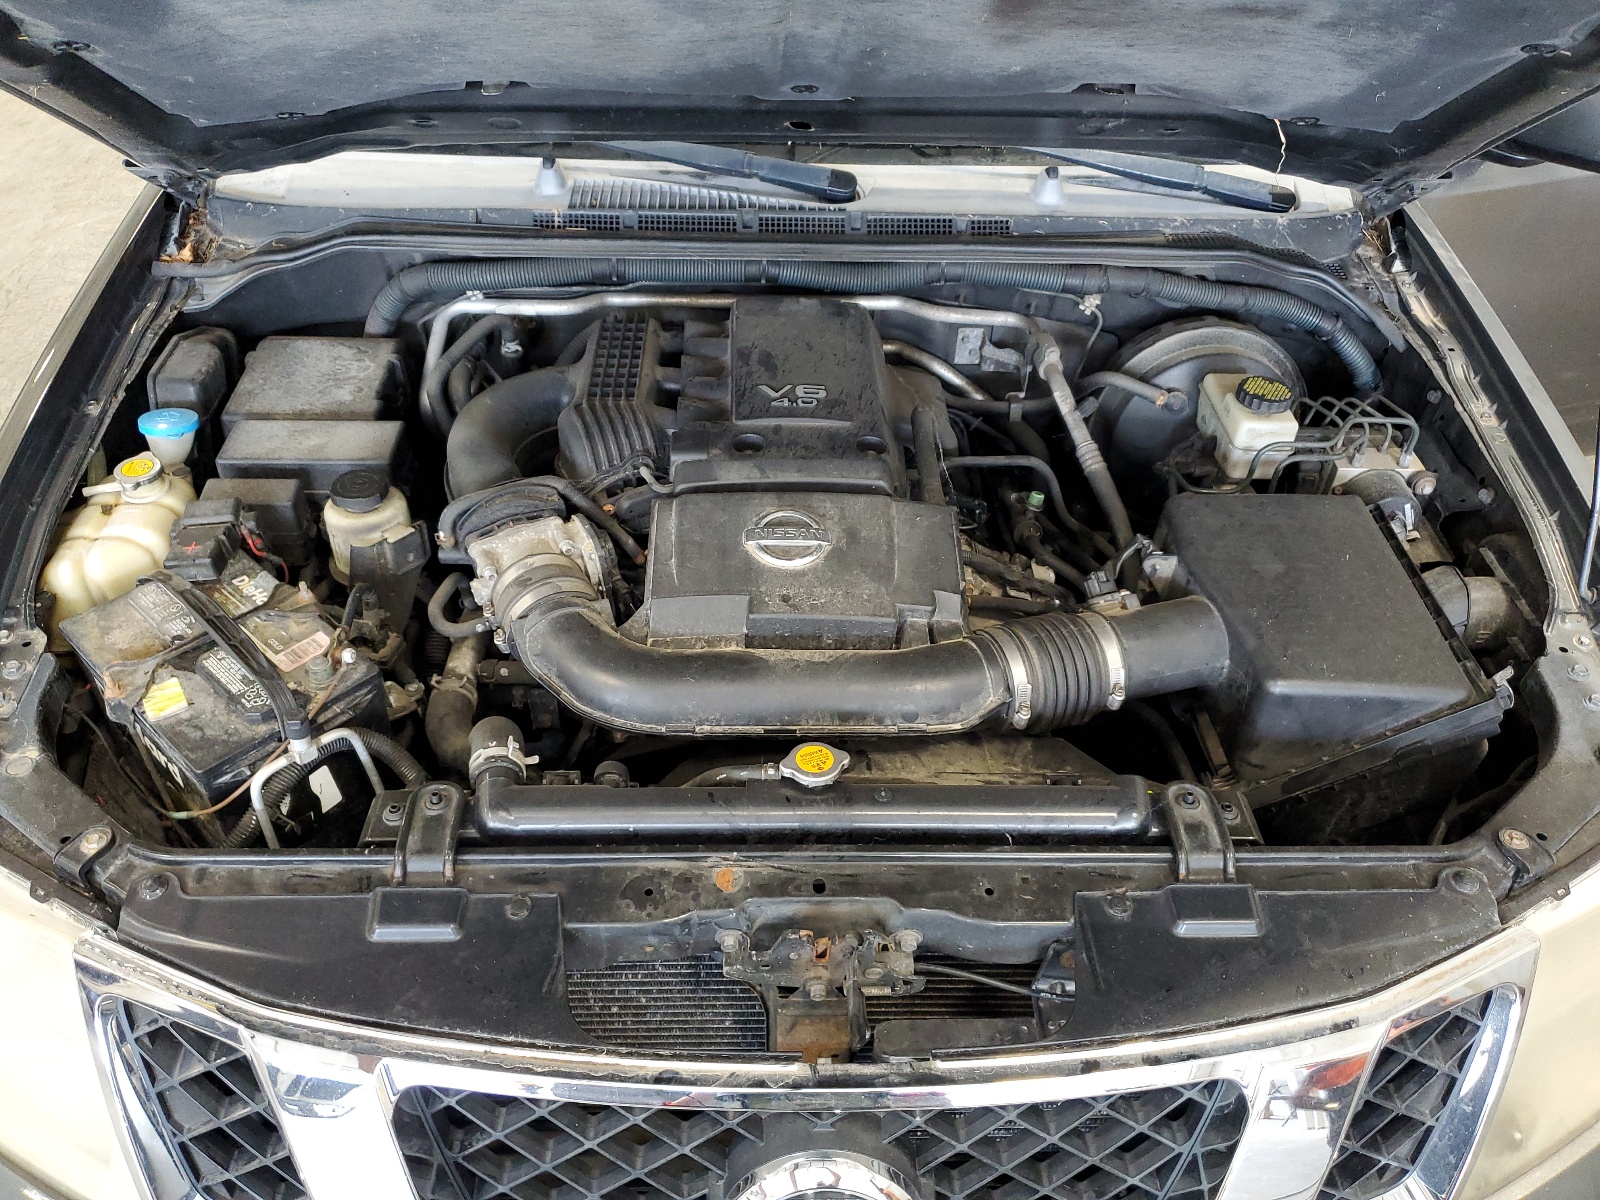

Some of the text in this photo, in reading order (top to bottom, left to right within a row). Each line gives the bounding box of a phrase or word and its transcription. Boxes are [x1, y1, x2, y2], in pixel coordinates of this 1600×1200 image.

[757, 384, 828, 398] V6
[770, 397, 818, 407] 4.0
[754, 528, 823, 539] NISSAN
[267, 638, 284, 651] GOLD
